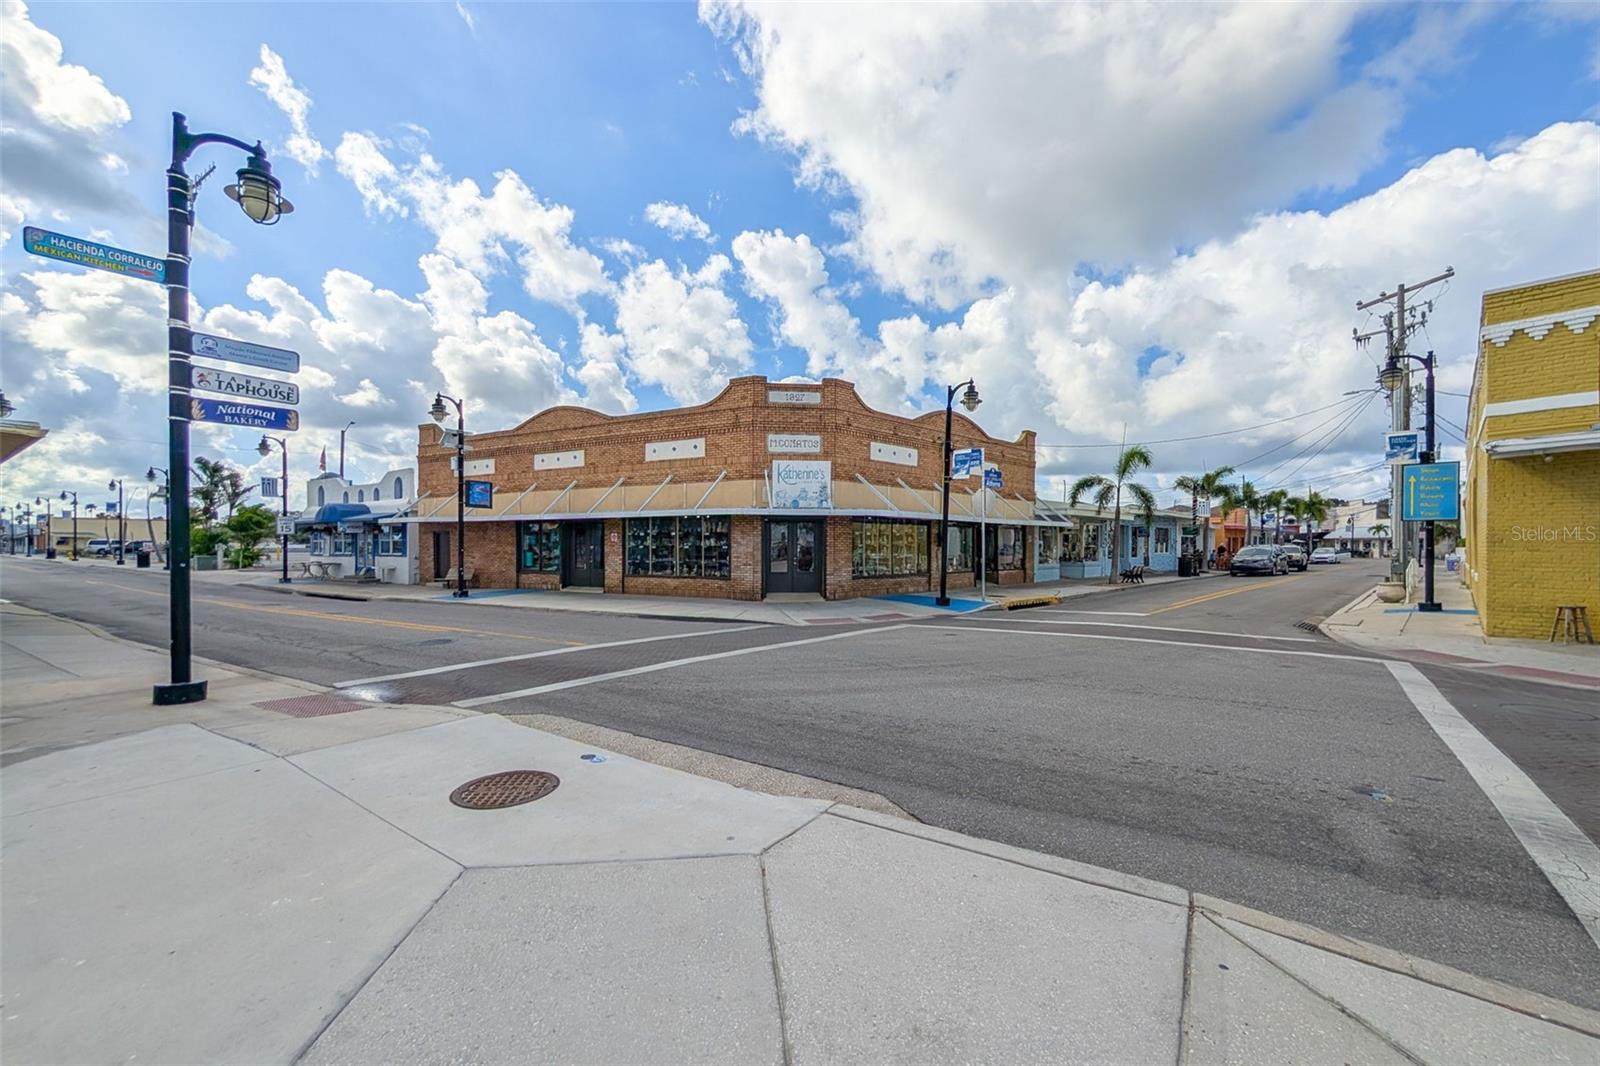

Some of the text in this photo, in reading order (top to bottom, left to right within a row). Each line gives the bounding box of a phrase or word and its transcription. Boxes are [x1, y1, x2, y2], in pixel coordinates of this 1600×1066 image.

[34, 244, 125, 271] MEXICAN KITCHEN
[50, 236, 163, 272] HACIENDA CORRALEJO
[215, 380, 294, 401] TAPHOUSE
[216, 404, 276, 420] National
[224, 415, 268, 426] BAKERY
[280, 525, 292, 533] 15
